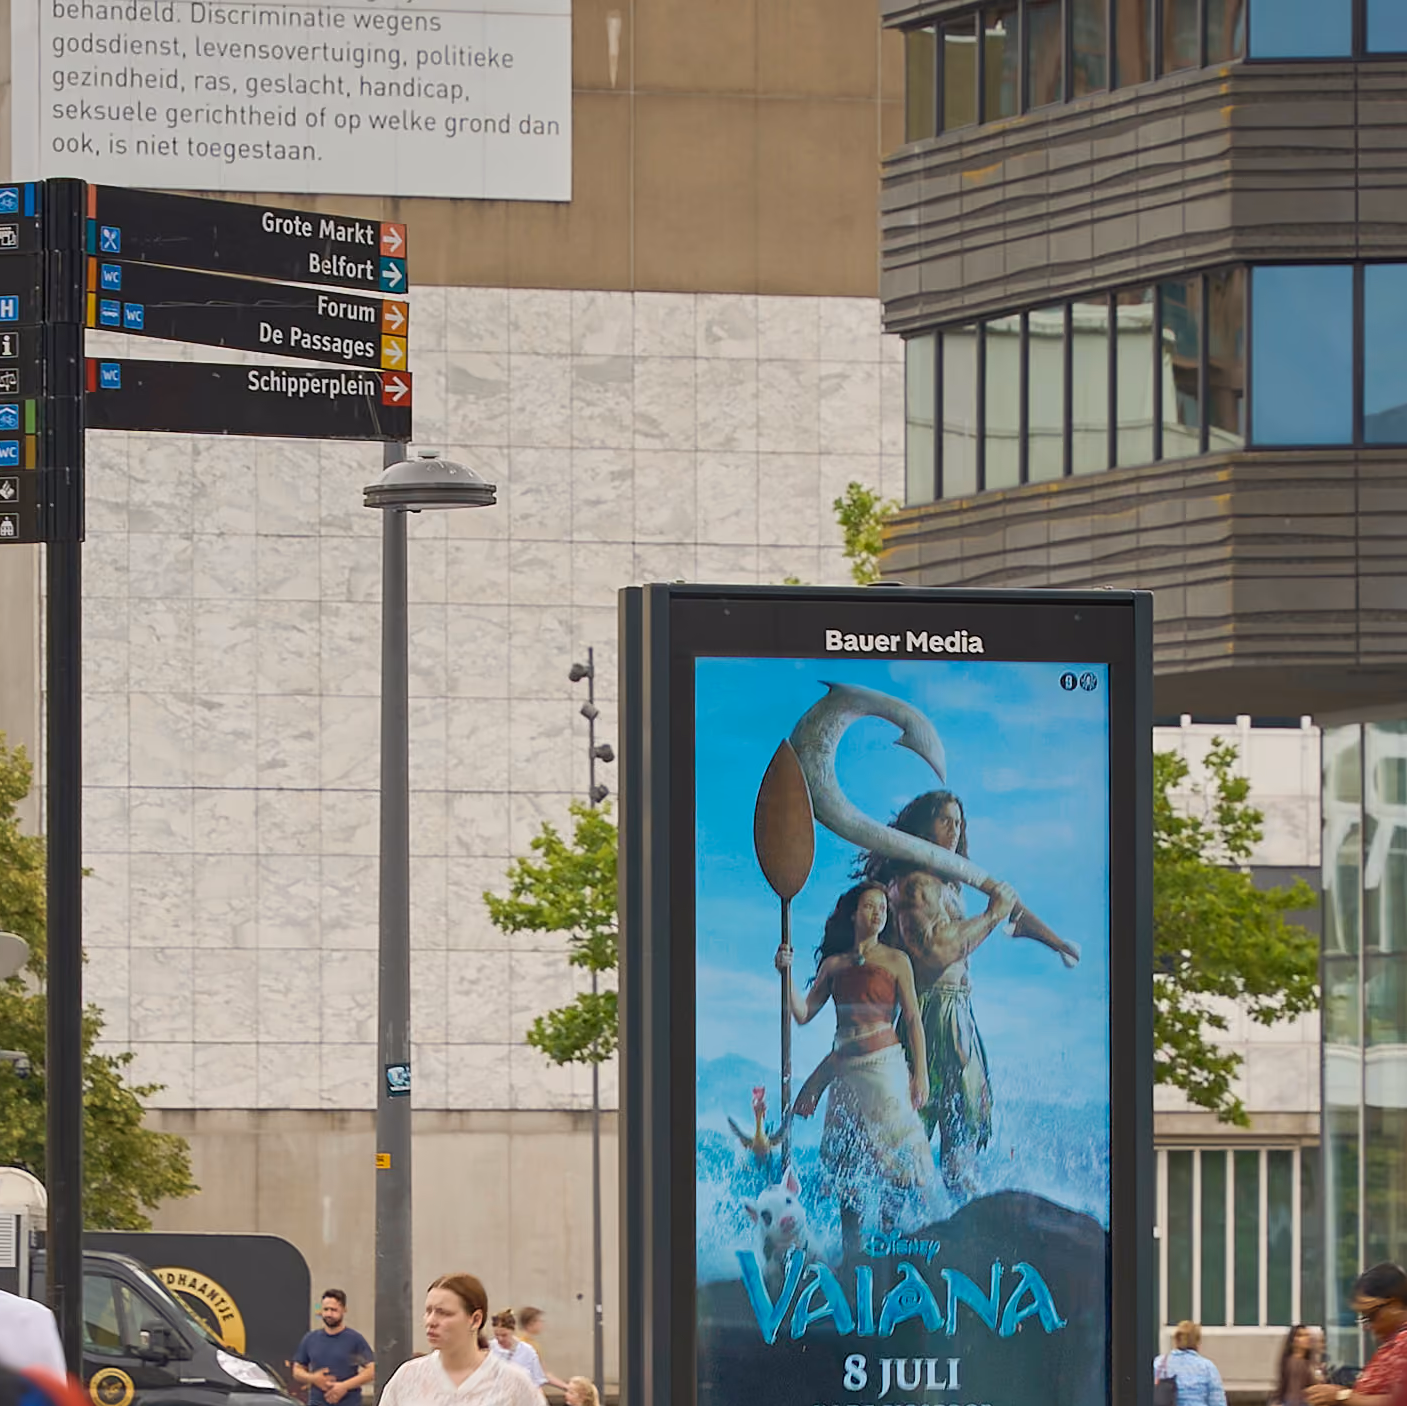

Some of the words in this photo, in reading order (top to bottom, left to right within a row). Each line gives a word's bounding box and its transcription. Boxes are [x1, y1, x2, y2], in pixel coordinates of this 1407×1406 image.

[52, 0, 181, 23] behandeld.
[191, 2, 345, 29] Discriminatie
[354, 14, 442, 36] wegens
[52, 34, 186, 59] godsdienst,
[195, 36, 408, 70] levensovertuiging,
[416, 44, 514, 70] politieke
[52, 66, 186, 92] gezindheid,
[194, 77, 238, 95] ras,
[245, 73, 351, 98] geslacht,
[359, 76, 470, 104] handicap,
[52, 99, 157, 122] seksuele
[165, 104, 296, 129] gerichtheid
[305, 107, 327, 128] of
[334, 112, 361, 134] op
[369, 109, 436, 131] welke
[445, 113, 510, 137] grond
[518, 114, 560, 135] dan
[52, 132, 100, 156] ook,
[109, 133, 127, 154] is
[136, 134, 178, 156] niet
[187, 137, 323, 163] toegestaan.
[262, 211, 313, 238] Grote
[318, 219, 374, 246] Markt
[309, 253, 374, 280] Belfort
[317, 295, 376, 323] Forum
[259, 322, 283, 345] De
[290, 325, 375, 359] Passages
[247, 370, 375, 398] Schipperplein
[825, 629, 900, 653] Bauer
[905, 630, 984, 654] Media
[736, 1243, 1068, 1345] VAIANA
[843, 1354, 868, 1392] 8
[878, 1357, 961, 1399] JULI
